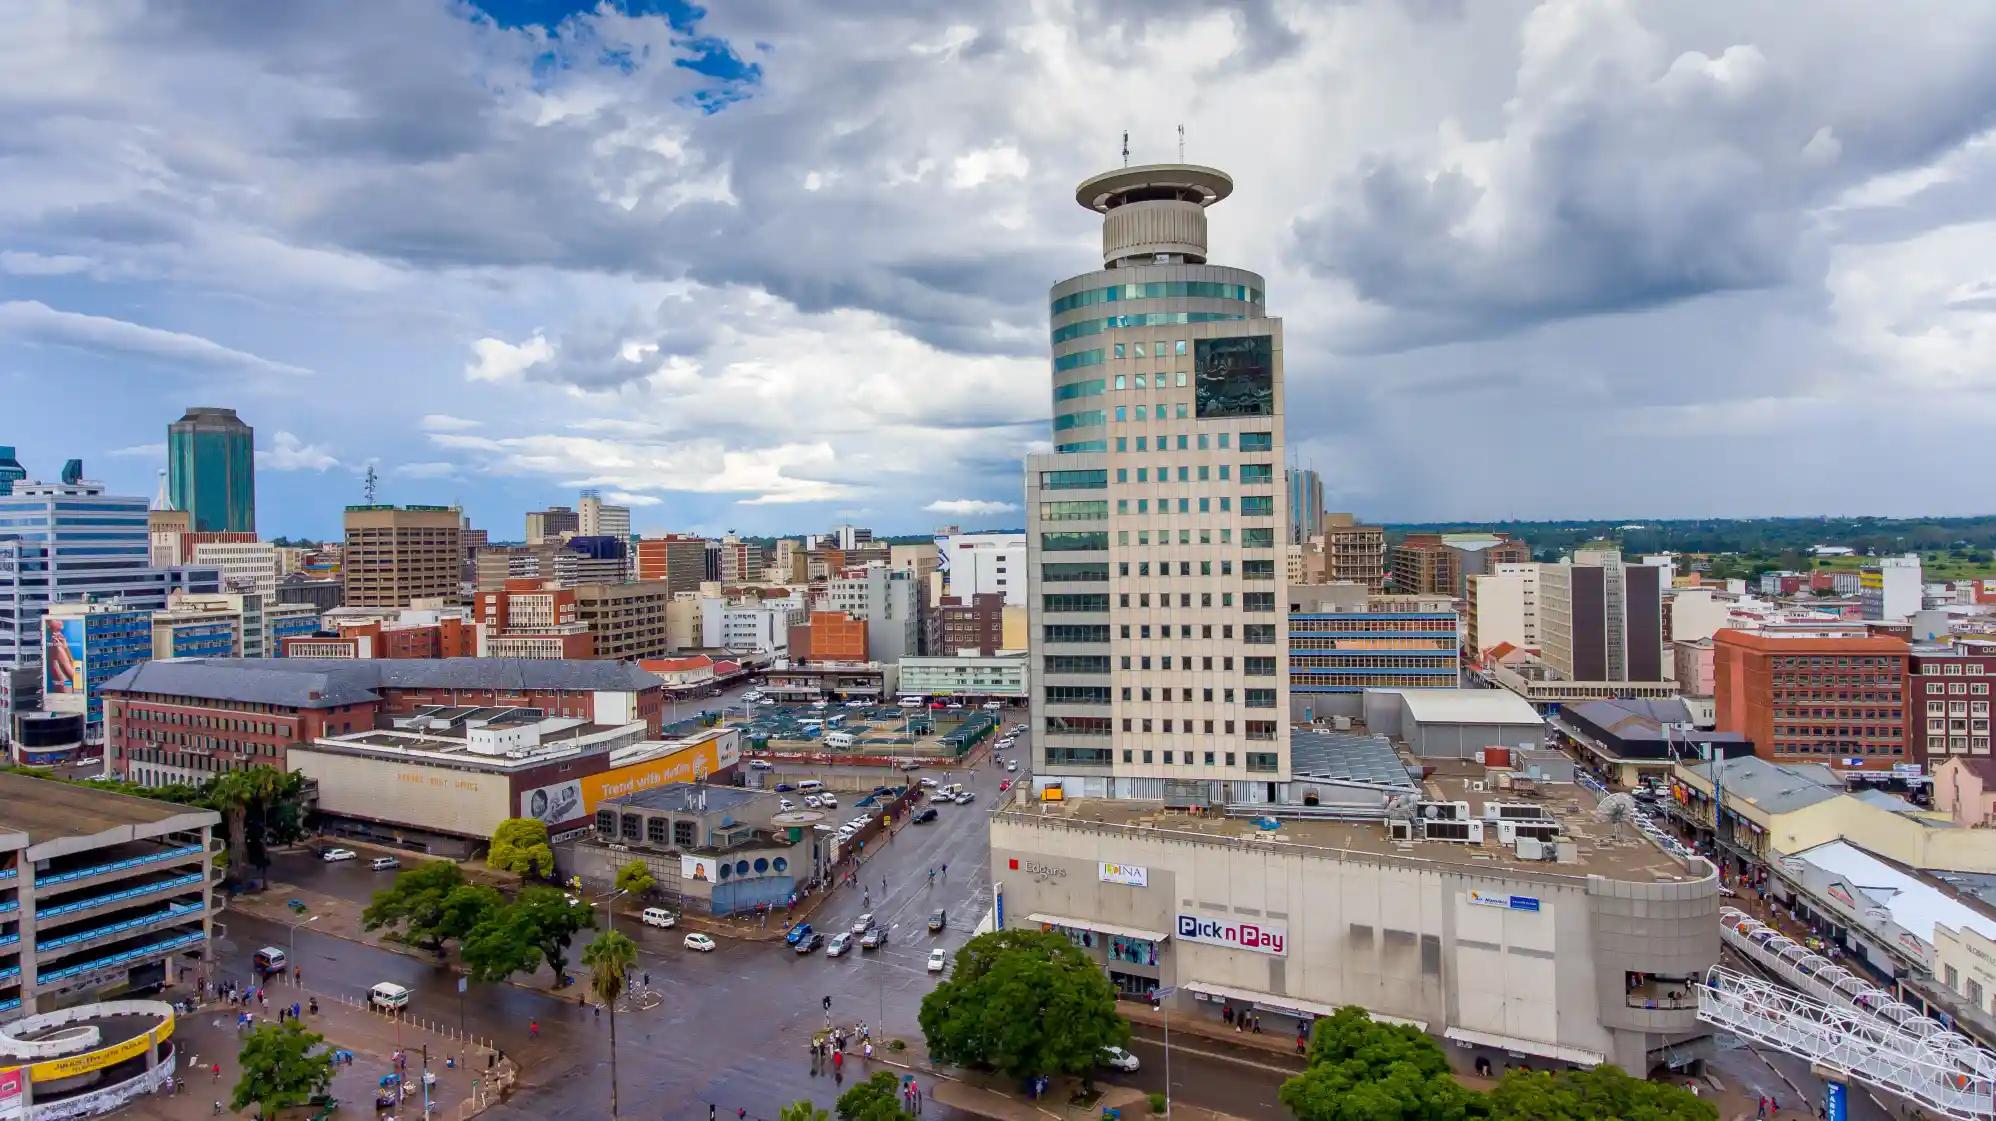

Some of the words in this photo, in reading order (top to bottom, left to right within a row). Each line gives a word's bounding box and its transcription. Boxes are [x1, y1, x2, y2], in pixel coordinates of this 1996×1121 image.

[602, 777, 634, 796] Trend
[637, 771, 660, 785] with
[1025, 861, 1067, 880] Edgars
[1179, 915, 1222, 939] Pick
[1225, 927, 1236, 941] n
[1240, 924, 1283, 952] Pay
